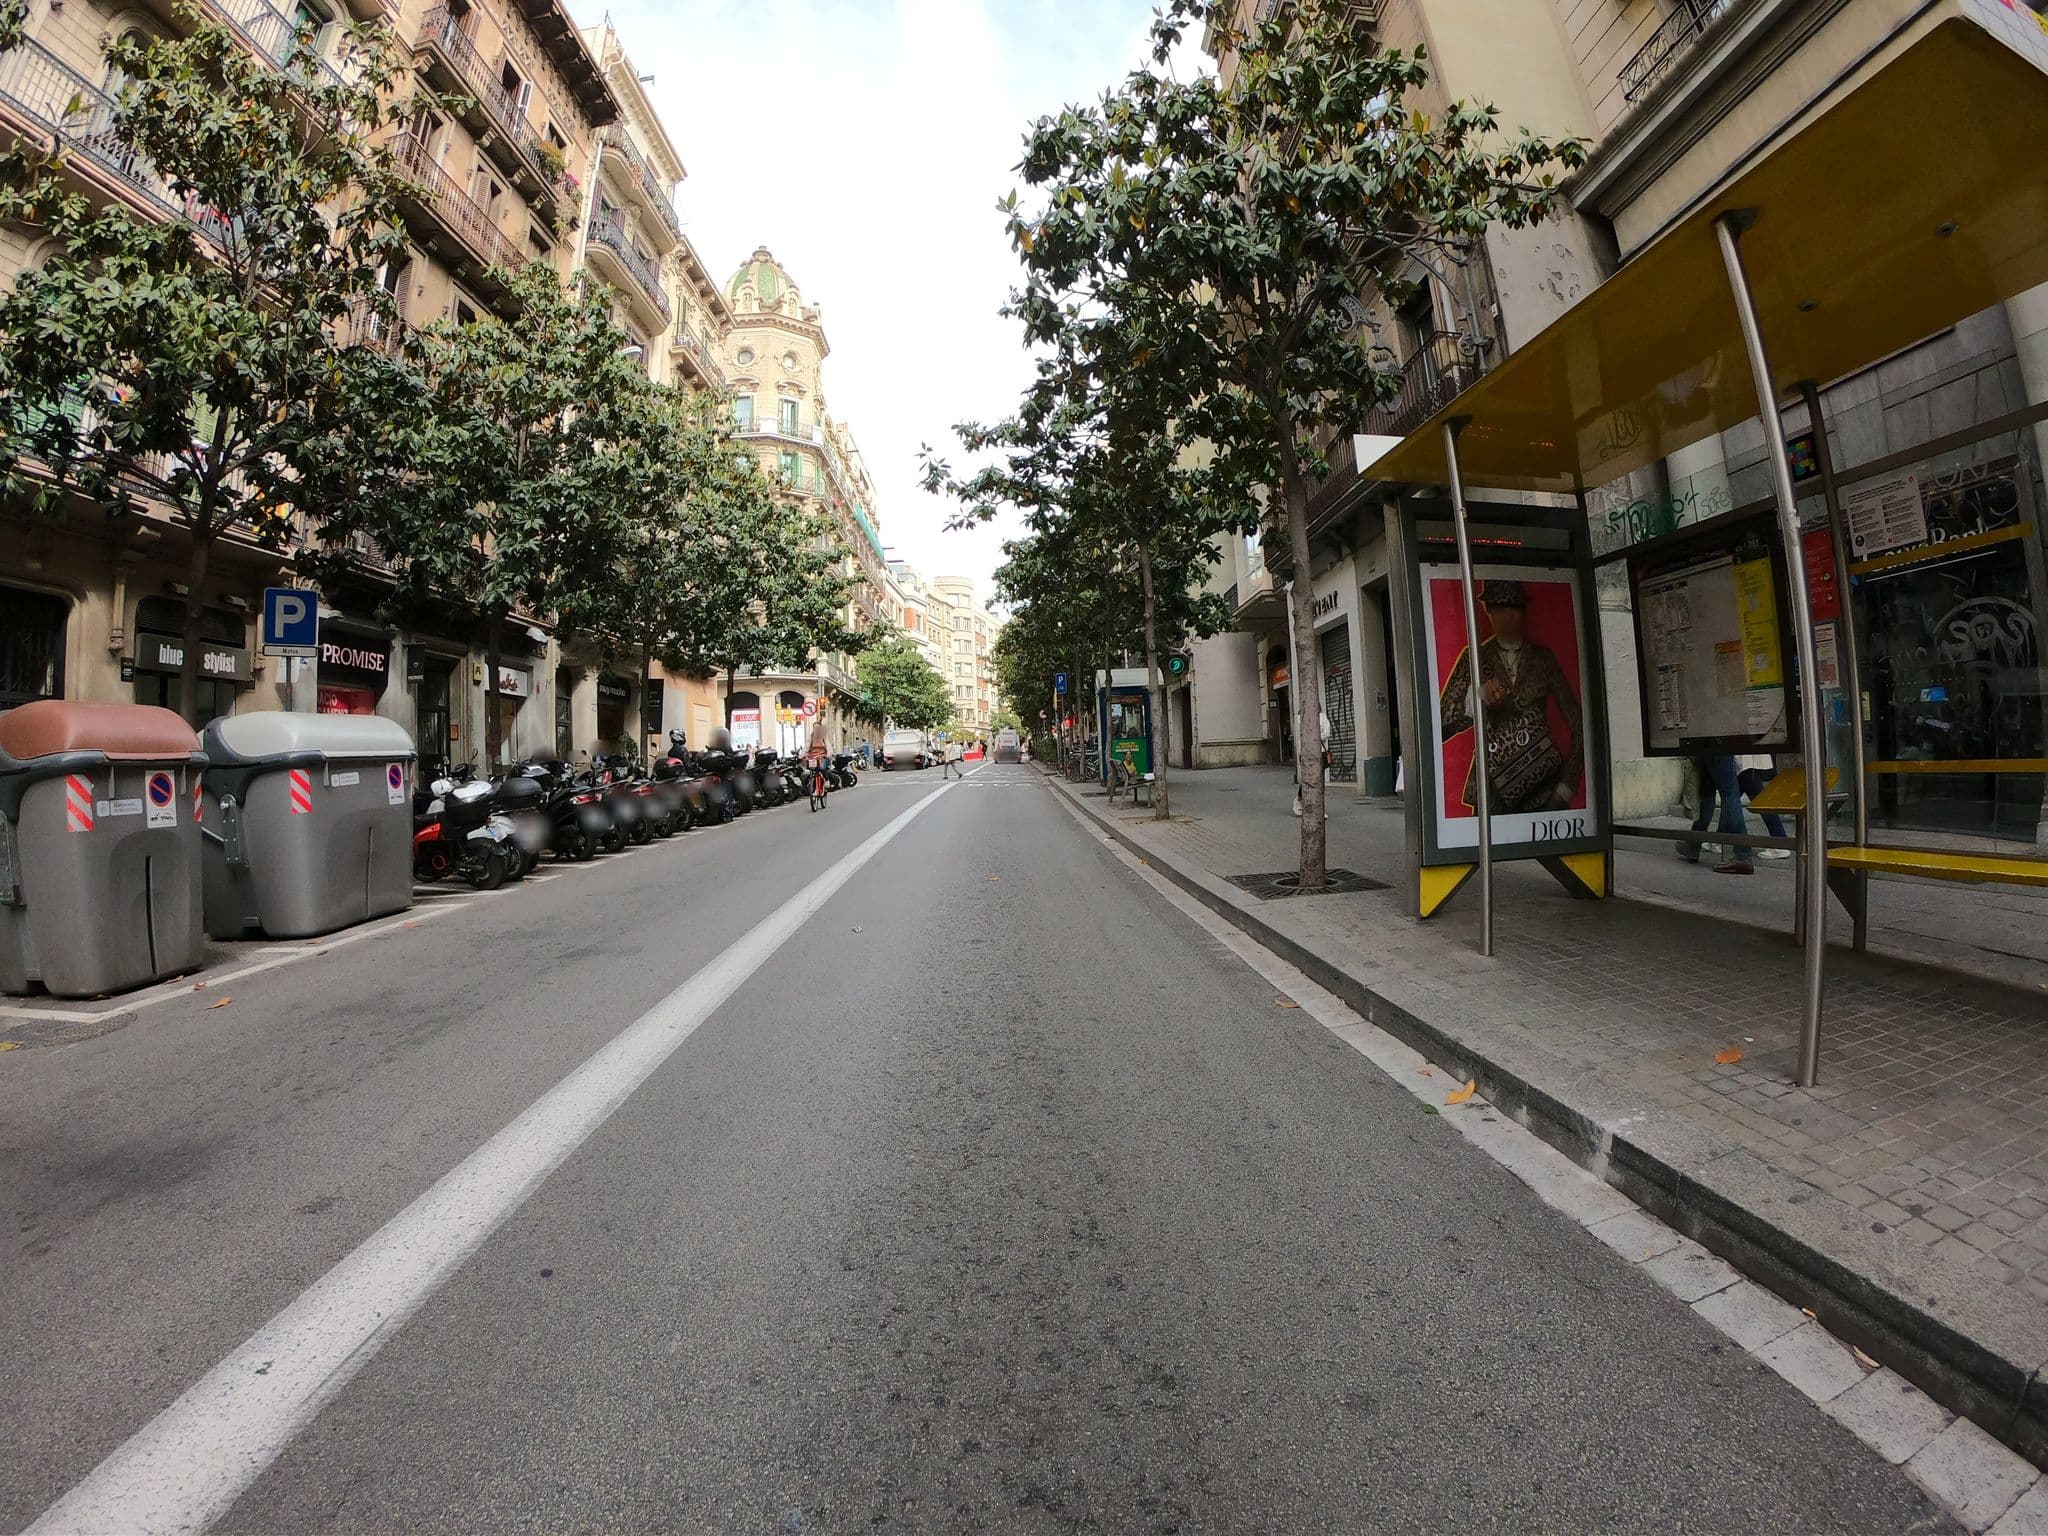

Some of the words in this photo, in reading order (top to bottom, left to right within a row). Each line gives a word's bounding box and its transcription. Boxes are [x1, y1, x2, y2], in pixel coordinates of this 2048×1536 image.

[275, 596, 306, 638] P
[159, 644, 183, 666] blue
[203, 652, 235, 674] stylist
[322, 643, 385, 672] PROMISE
[1529, 817, 1585, 842] DIOR
